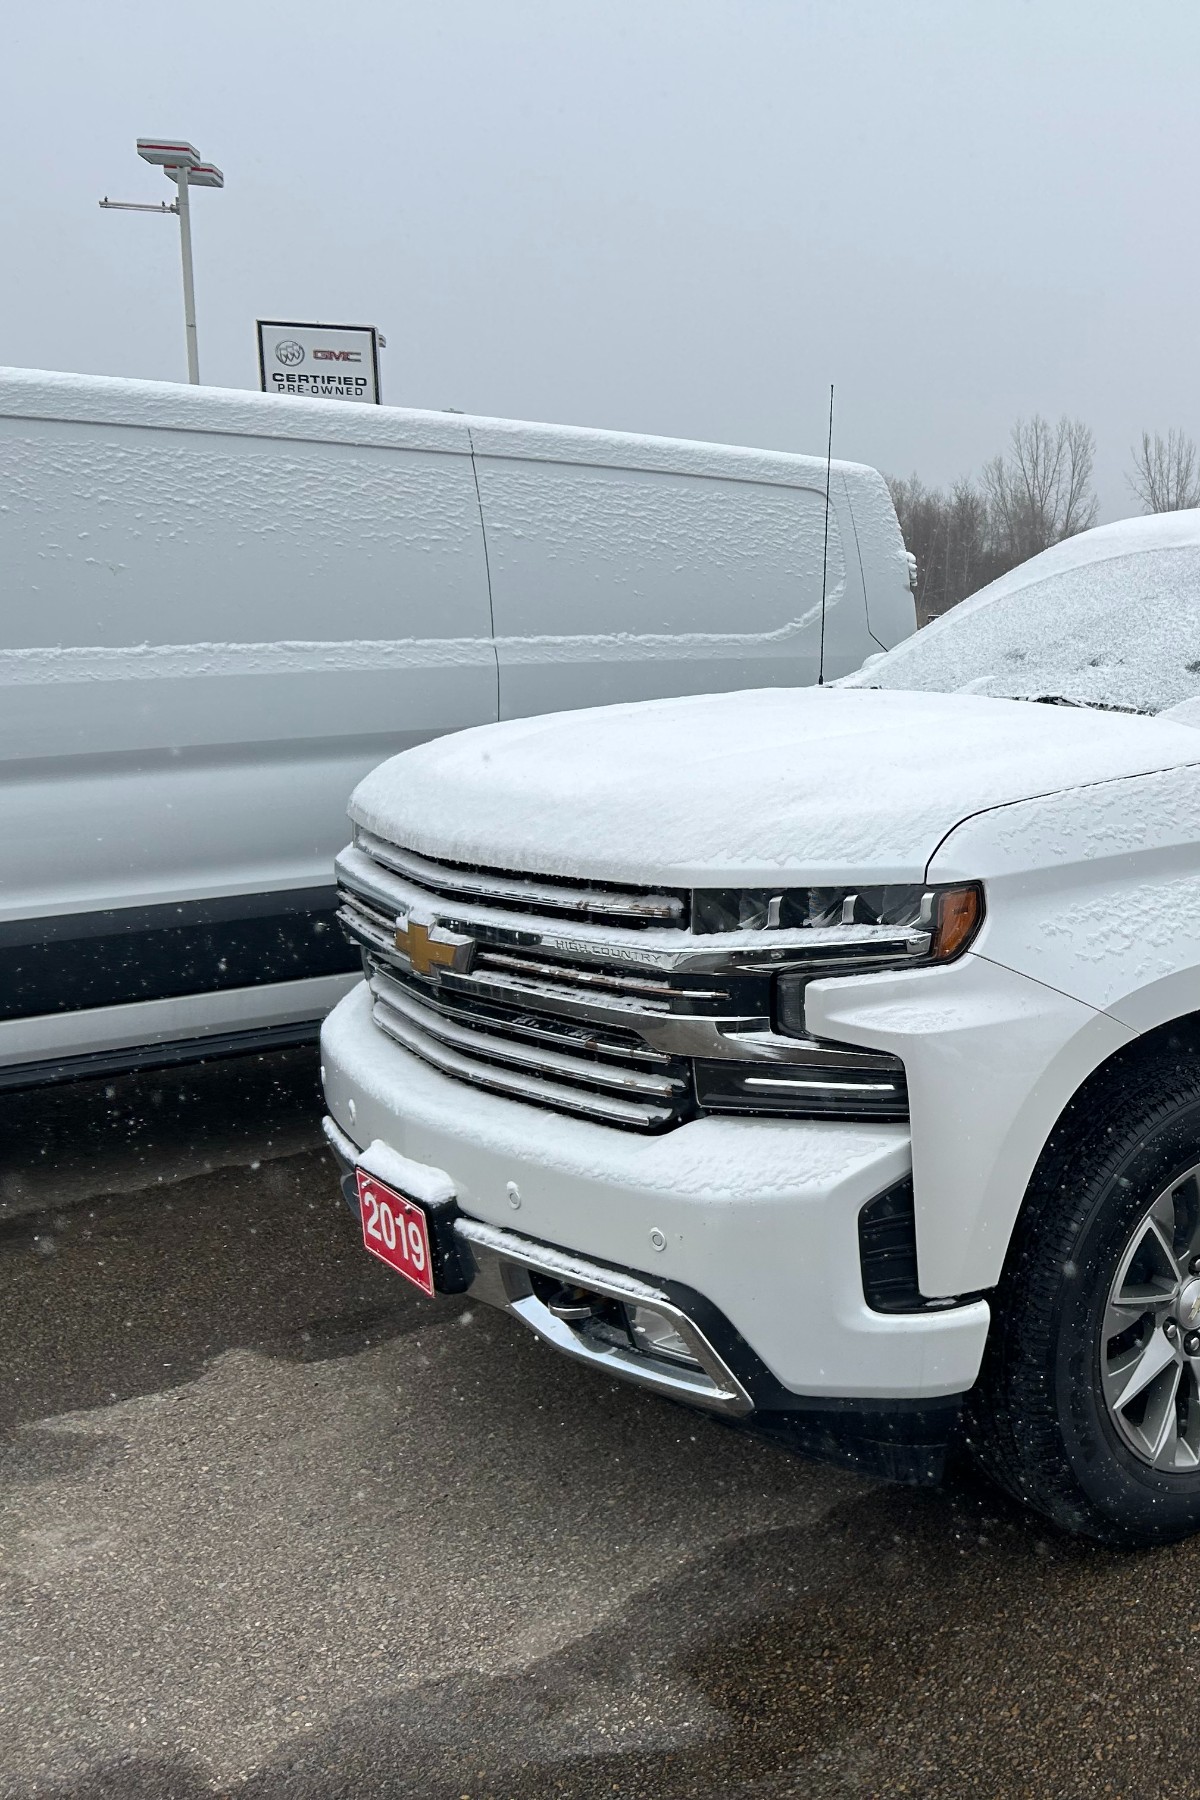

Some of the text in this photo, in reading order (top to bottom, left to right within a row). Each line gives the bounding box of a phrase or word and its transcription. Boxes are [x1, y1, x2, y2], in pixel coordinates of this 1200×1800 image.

[313, 350, 362, 362] GMC
[272, 373, 367, 386] CERTIFIED
[278, 384, 363, 396] PRE-OWNED
[555, 940, 661, 962] HIGH COUNTRY
[364, 1191, 425, 1271] 2019
